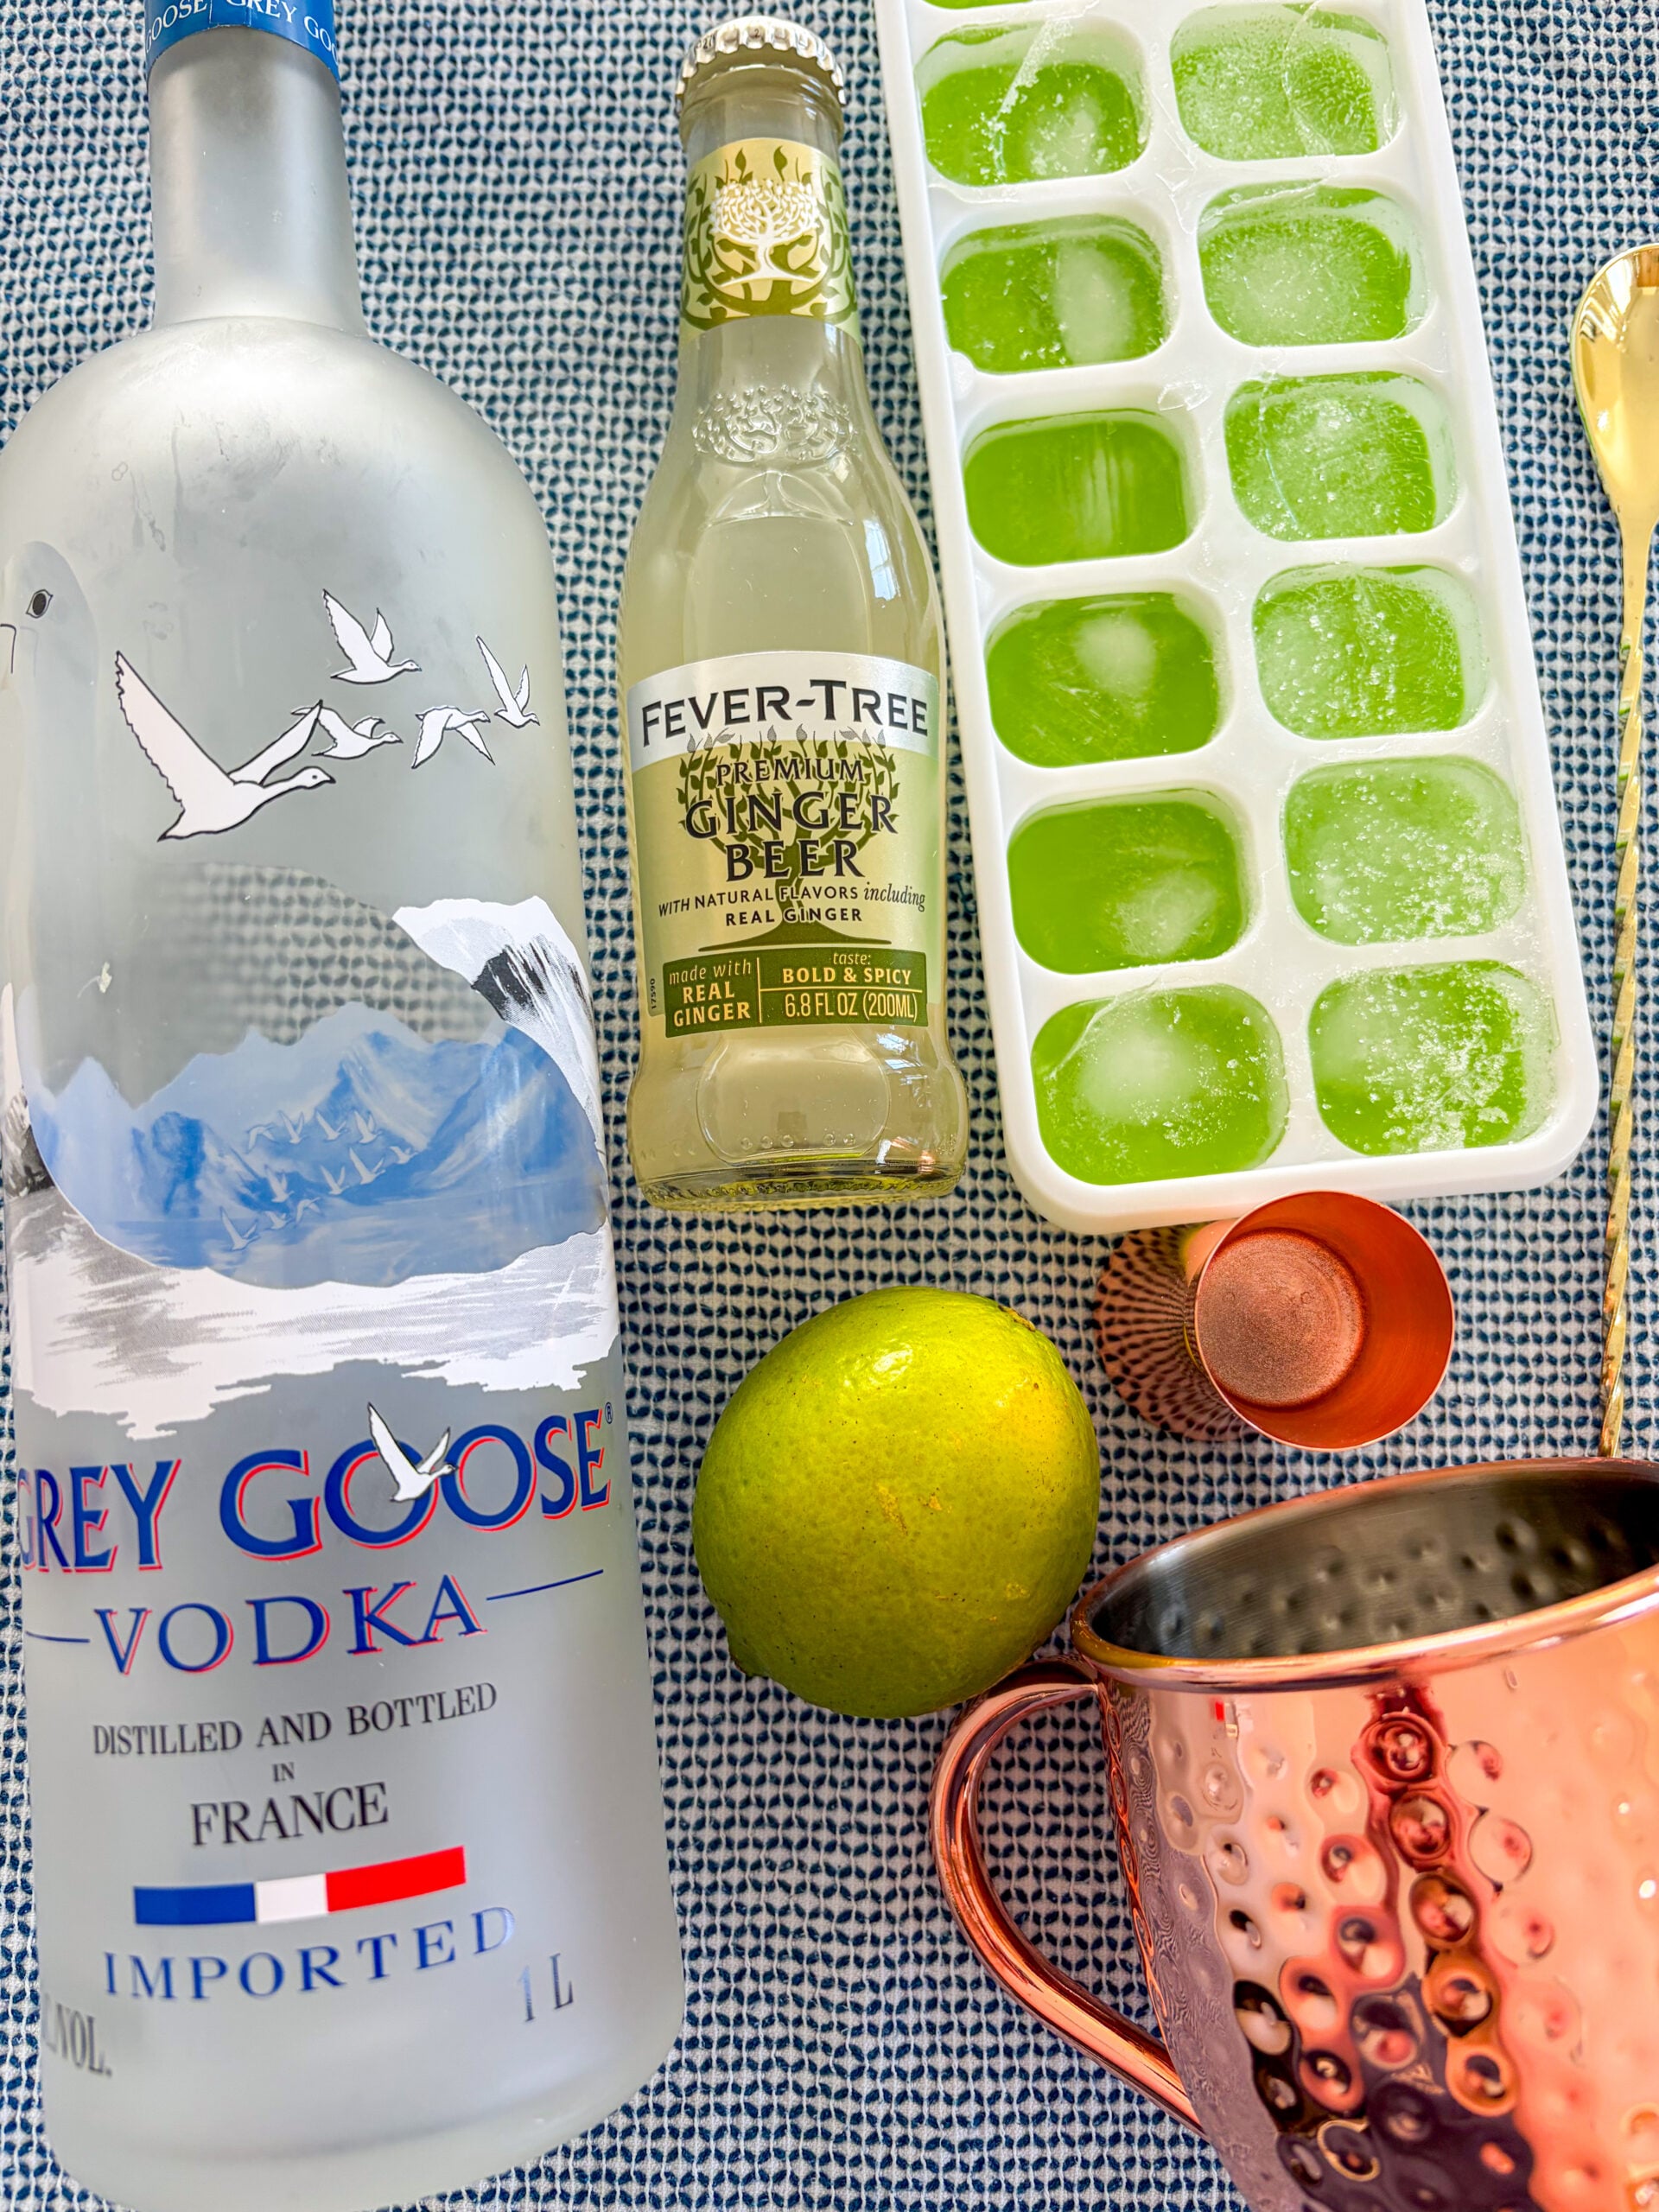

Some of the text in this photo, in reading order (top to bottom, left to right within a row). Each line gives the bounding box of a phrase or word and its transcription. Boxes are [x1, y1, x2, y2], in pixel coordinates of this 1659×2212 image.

[642, 678, 929, 748] FEVER-TREE
[716, 757, 865, 787] PREMIUM
[685, 791, 899, 839] GINGER
[725, 839, 865, 881] BEER
[658, 880, 926, 918] WITH NATURAL FLAVORS including
[726, 907, 863, 927] REAL GINGER
[669, 957, 752, 986] made with
[782, 966, 912, 986] BOLD & SPICY
[832, 951, 871, 966] taste:
[682, 980, 735, 1005] REAL
[785, 989, 918, 1023] 6.8 FL OZ (200ML)
[673, 1001, 752, 1028] GINGER
[17, 1458, 182, 1573] GREY
[94, 1574, 488, 1676] VODKA
[92, 1681, 499, 1756] DISTILLED AND BOTTLED
[272, 1761, 296, 1783] IN
[191, 1781, 390, 1847] FRANCE
[104, 1906, 516, 2000] IMPORTED
[550, 1953, 575, 2012] L
